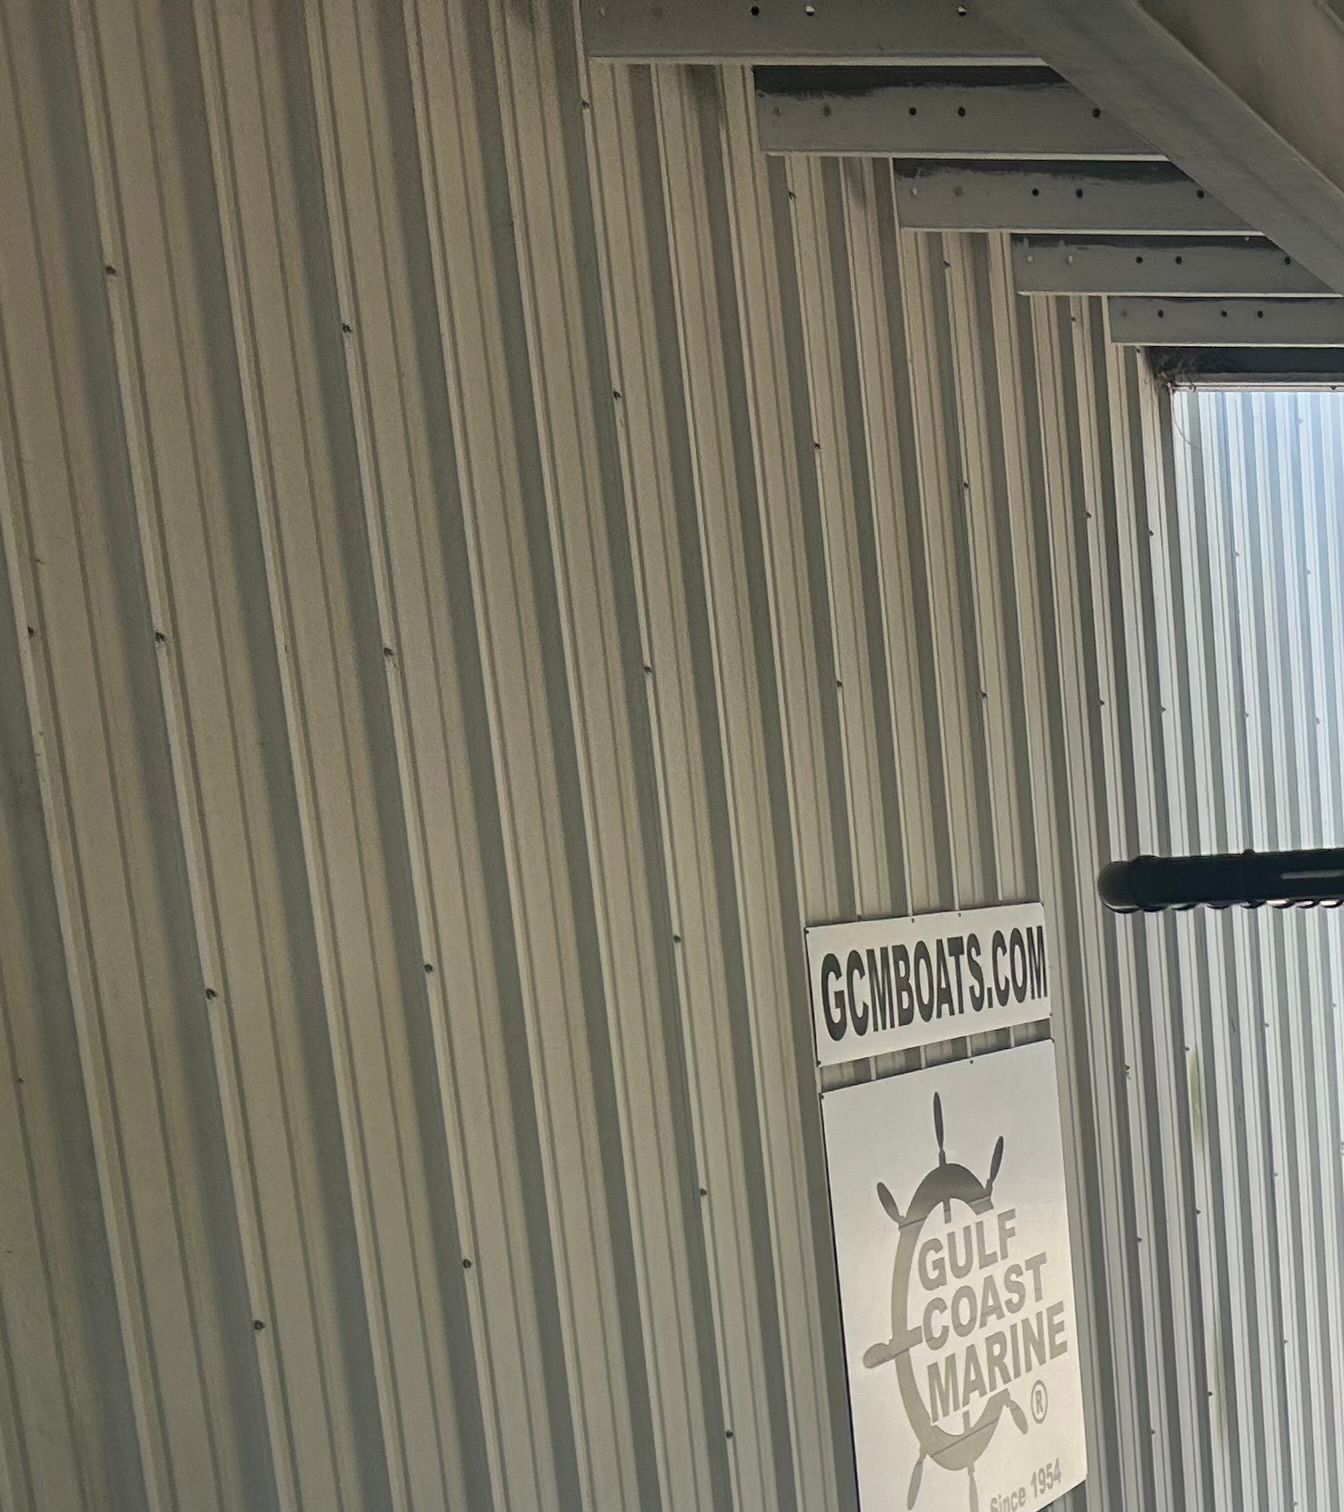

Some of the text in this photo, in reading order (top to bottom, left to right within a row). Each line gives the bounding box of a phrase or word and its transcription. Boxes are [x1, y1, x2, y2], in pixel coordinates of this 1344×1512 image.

[821, 925, 1048, 1041] GCMBOATS.COM
[918, 1208, 1016, 1291] GULF
[923, 1251, 1047, 1351] COAST
[927, 1301, 1068, 1424] MARINE
[1030, 1457, 1062, 1499] 1954
